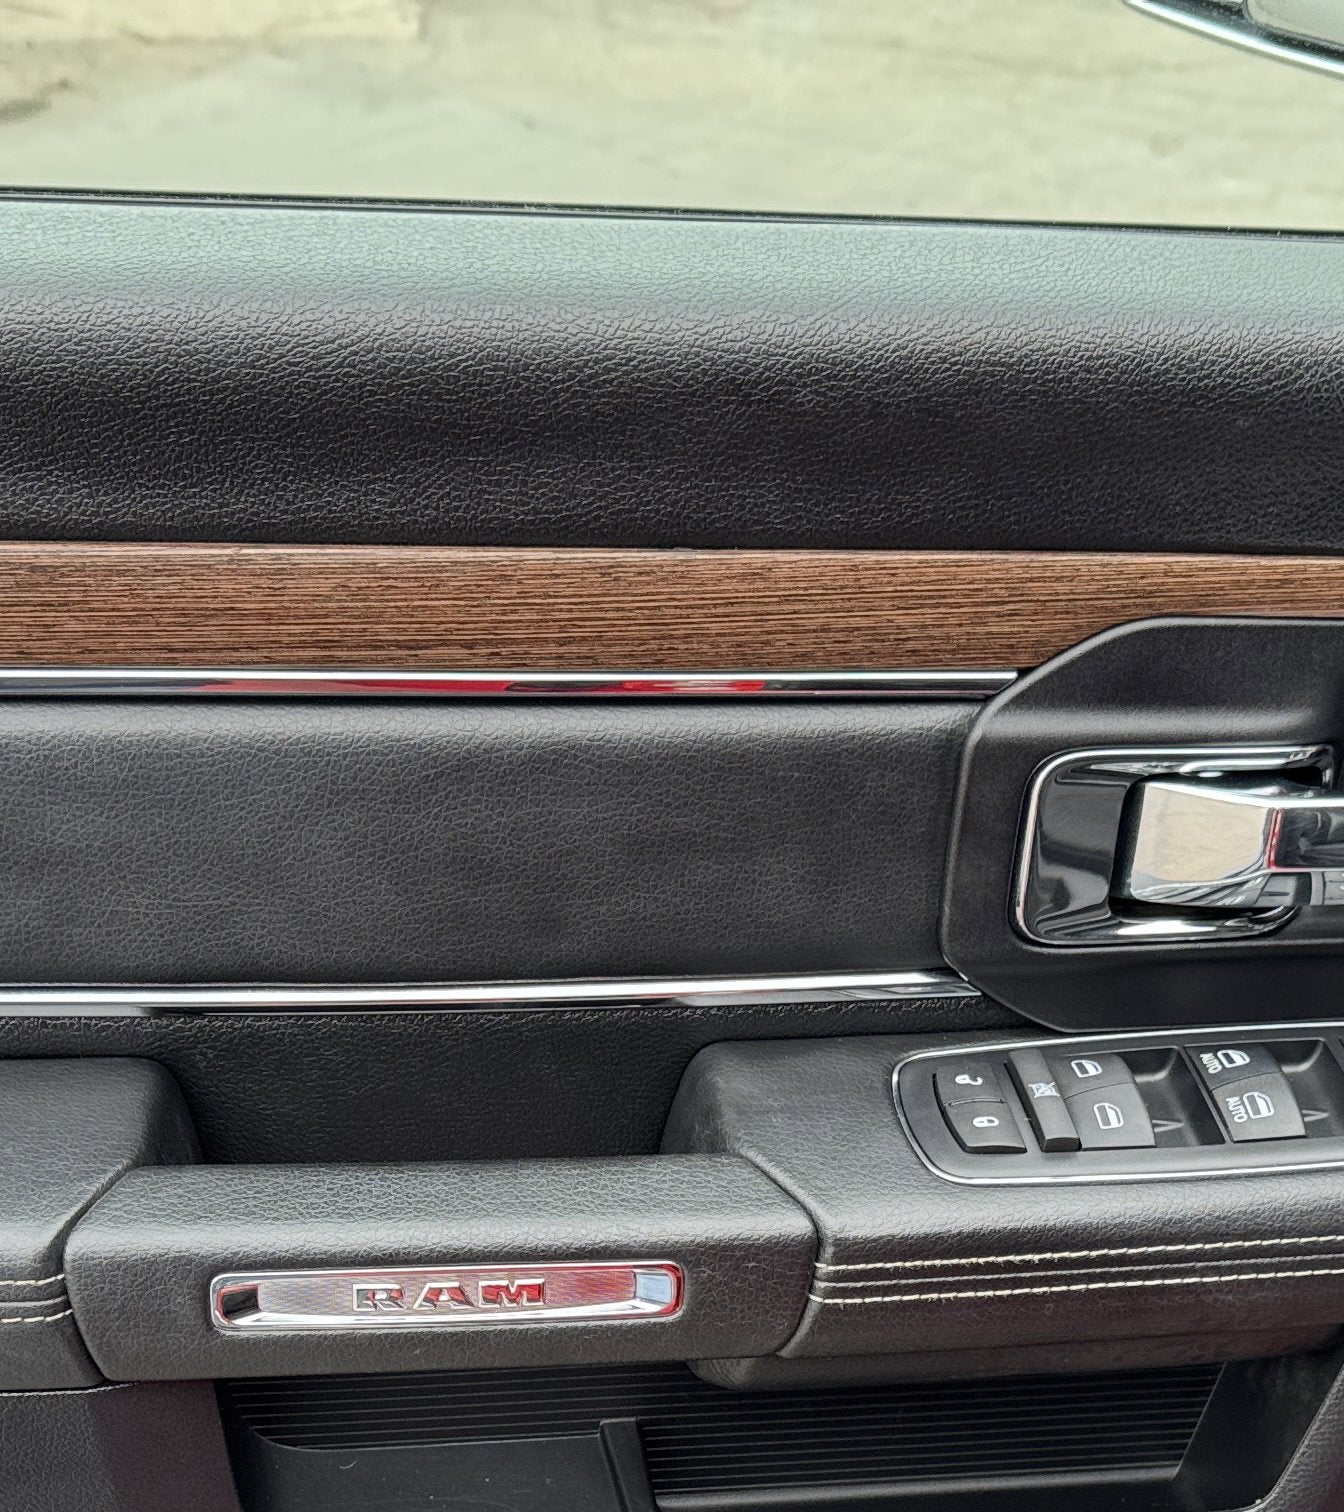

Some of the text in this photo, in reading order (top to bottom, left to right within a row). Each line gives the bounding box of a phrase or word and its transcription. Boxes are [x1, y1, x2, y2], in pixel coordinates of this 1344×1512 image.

[1199, 1051, 1223, 1075] AUTO
[1225, 1095, 1249, 1123] AUTO
[352, 1277, 546, 1311] RAM
